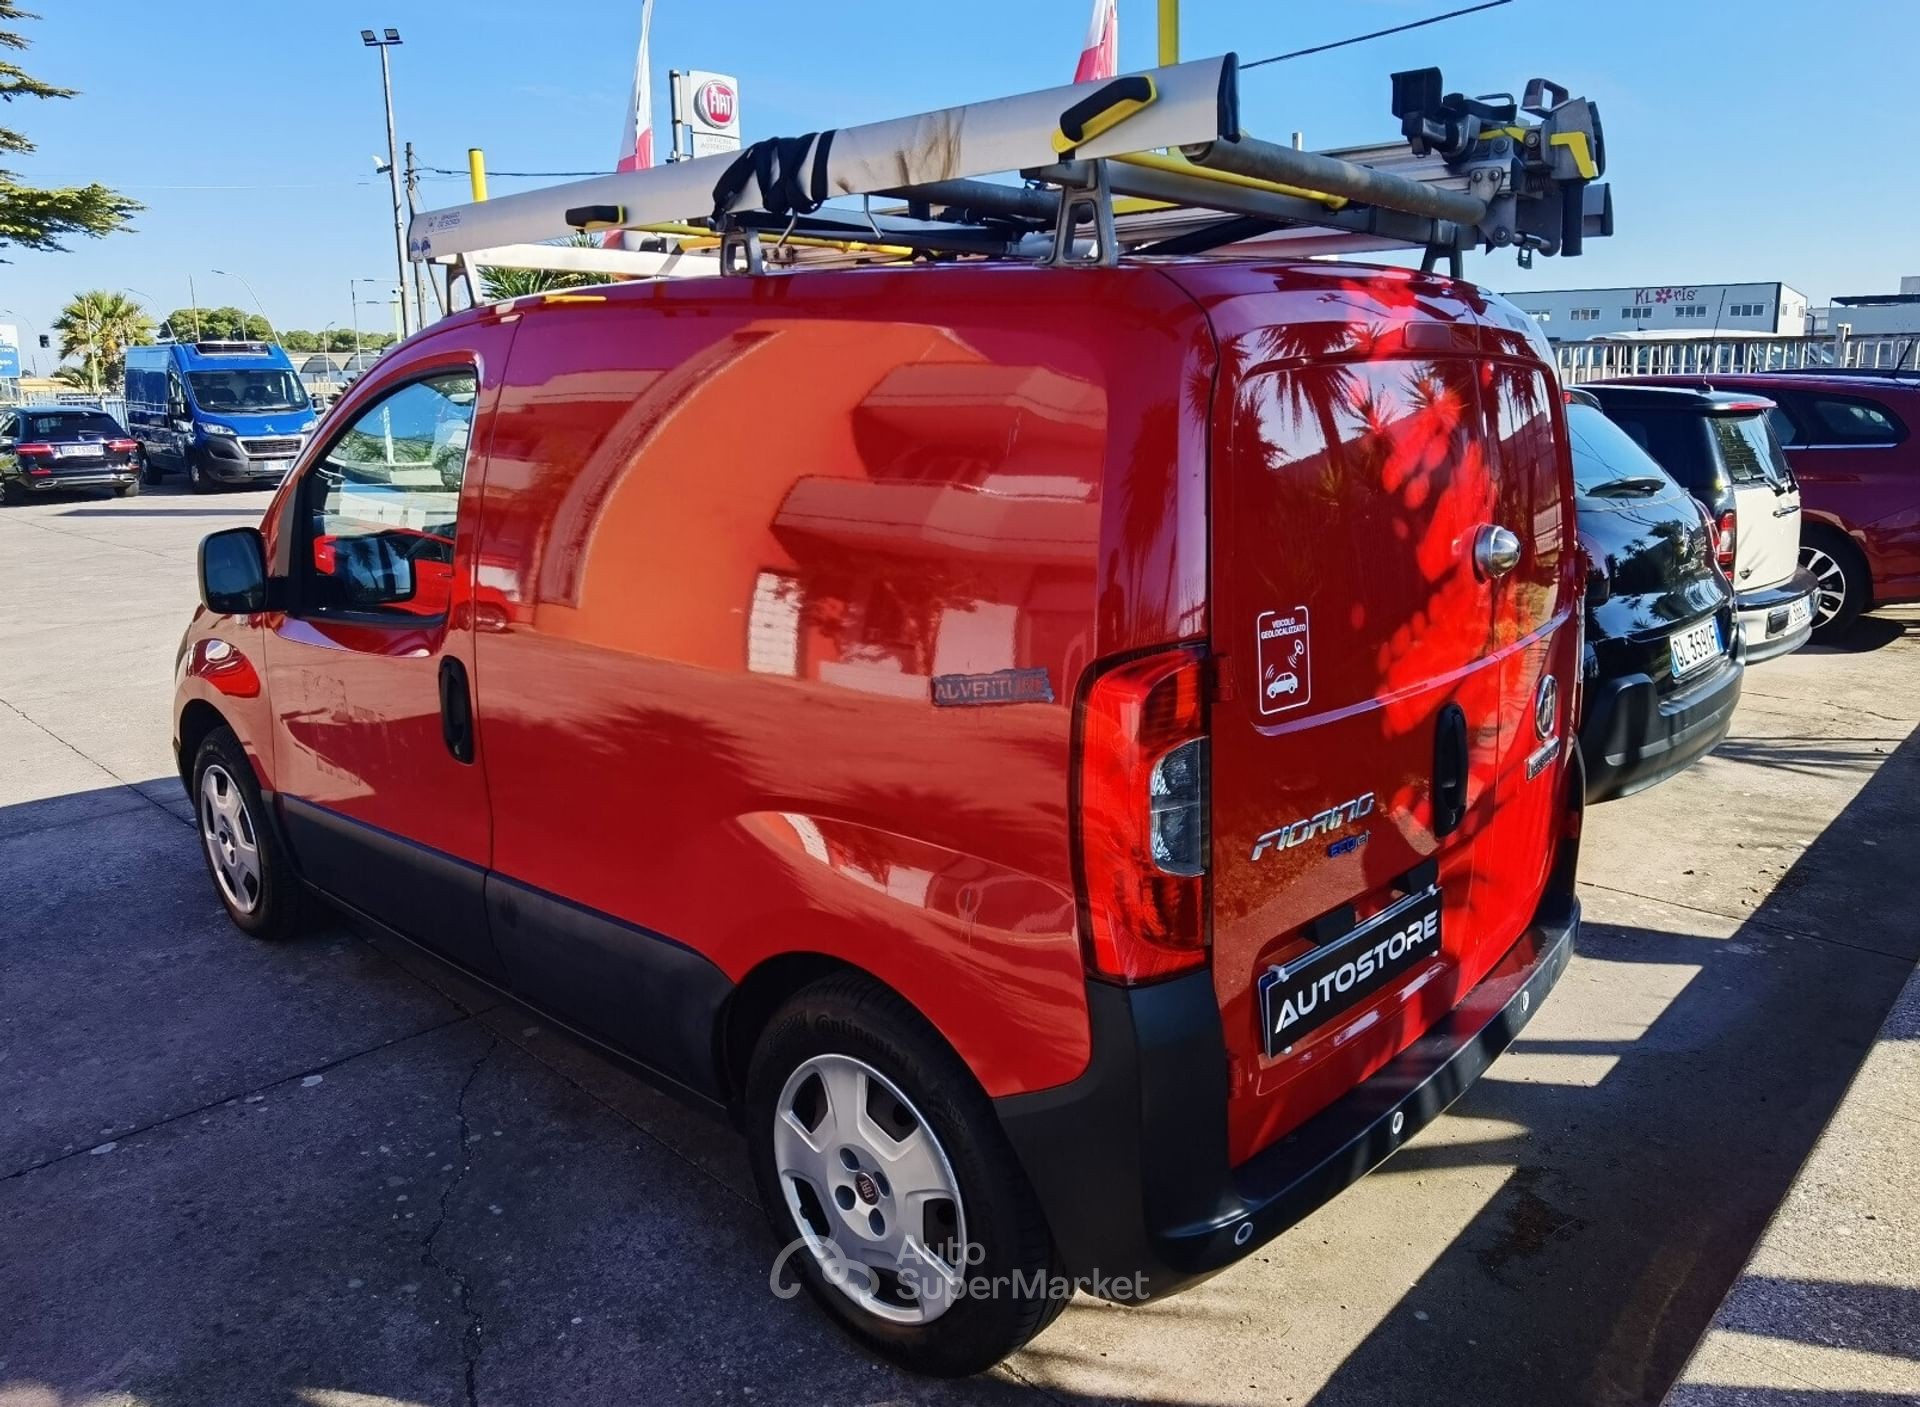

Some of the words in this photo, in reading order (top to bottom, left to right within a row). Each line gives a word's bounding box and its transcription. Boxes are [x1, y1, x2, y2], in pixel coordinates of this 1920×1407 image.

[710, 91, 732, 117] FIAT
[1261, 624, 1306, 639] GEOLOCALIZZATO
[1272, 617, 1295, 629] VEICOLO
[935, 677, 1043, 700] ADVENTU
[1251, 792, 1374, 861] FIORINO
[1275, 910, 1438, 1034] AUTOSTORE
[859, 1179, 875, 1199] FIAT
